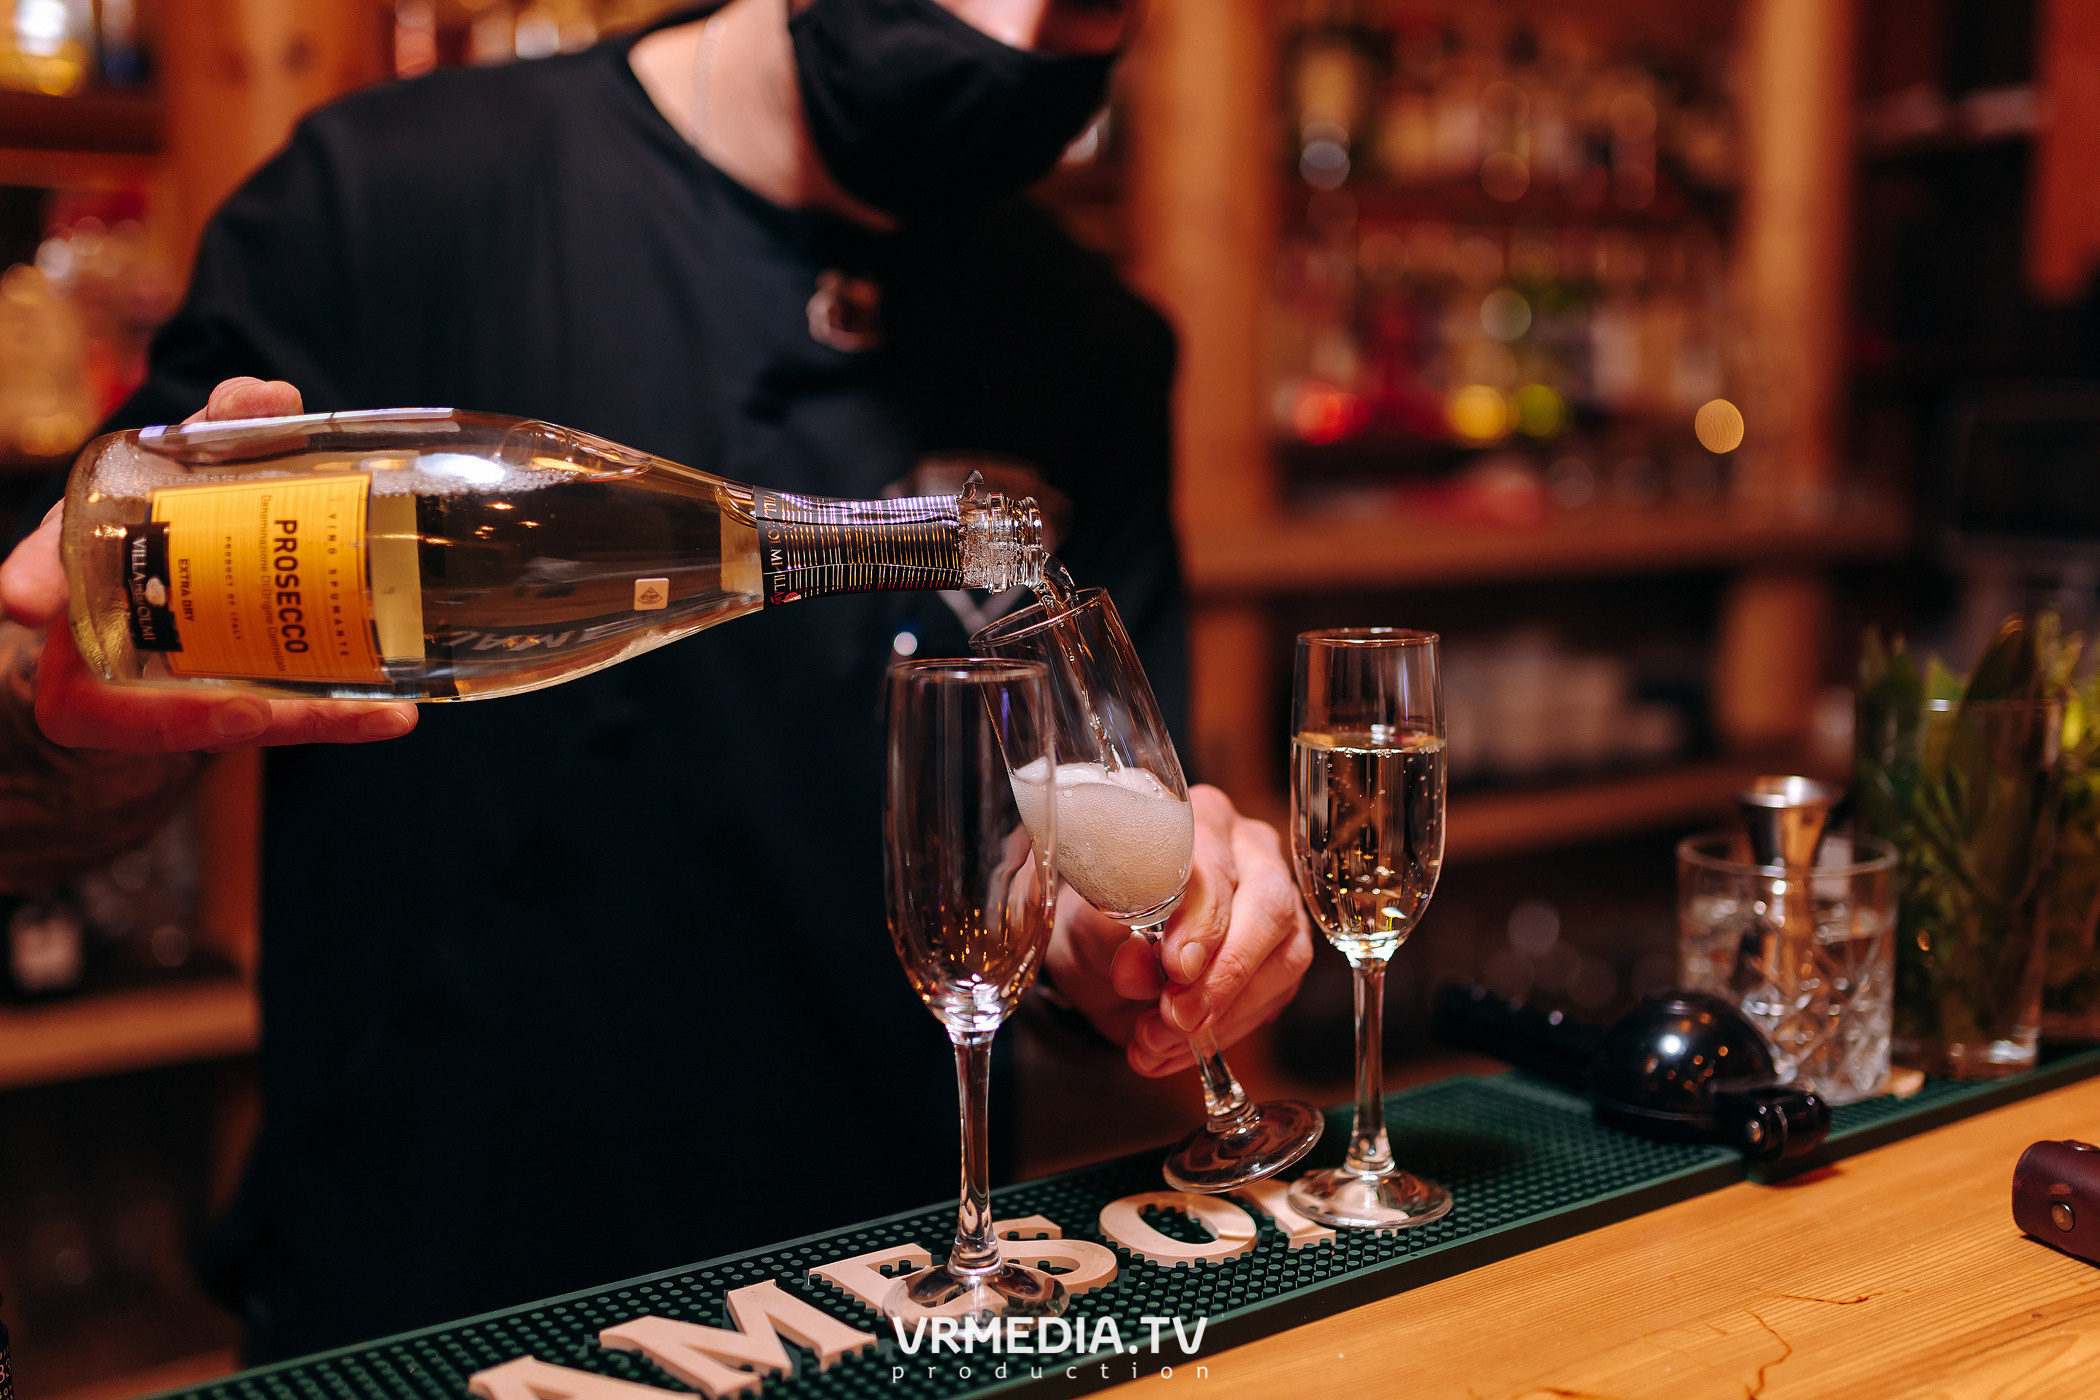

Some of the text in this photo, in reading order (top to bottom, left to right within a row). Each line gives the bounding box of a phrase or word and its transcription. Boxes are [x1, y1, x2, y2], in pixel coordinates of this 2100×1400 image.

[131, 537, 148, 582] VILLA
[259, 494, 272, 572] Denominazione
[178, 558, 195, 622] EXTRA DRY
[223, 536, 242, 641] PRODUCT OF ITALY
[261, 588, 274, 624] Origine
[273, 519, 309, 654] PROSECCO
[327, 513, 349, 657] VINO SPUMANTE
[136, 606, 156, 641] OLMI
